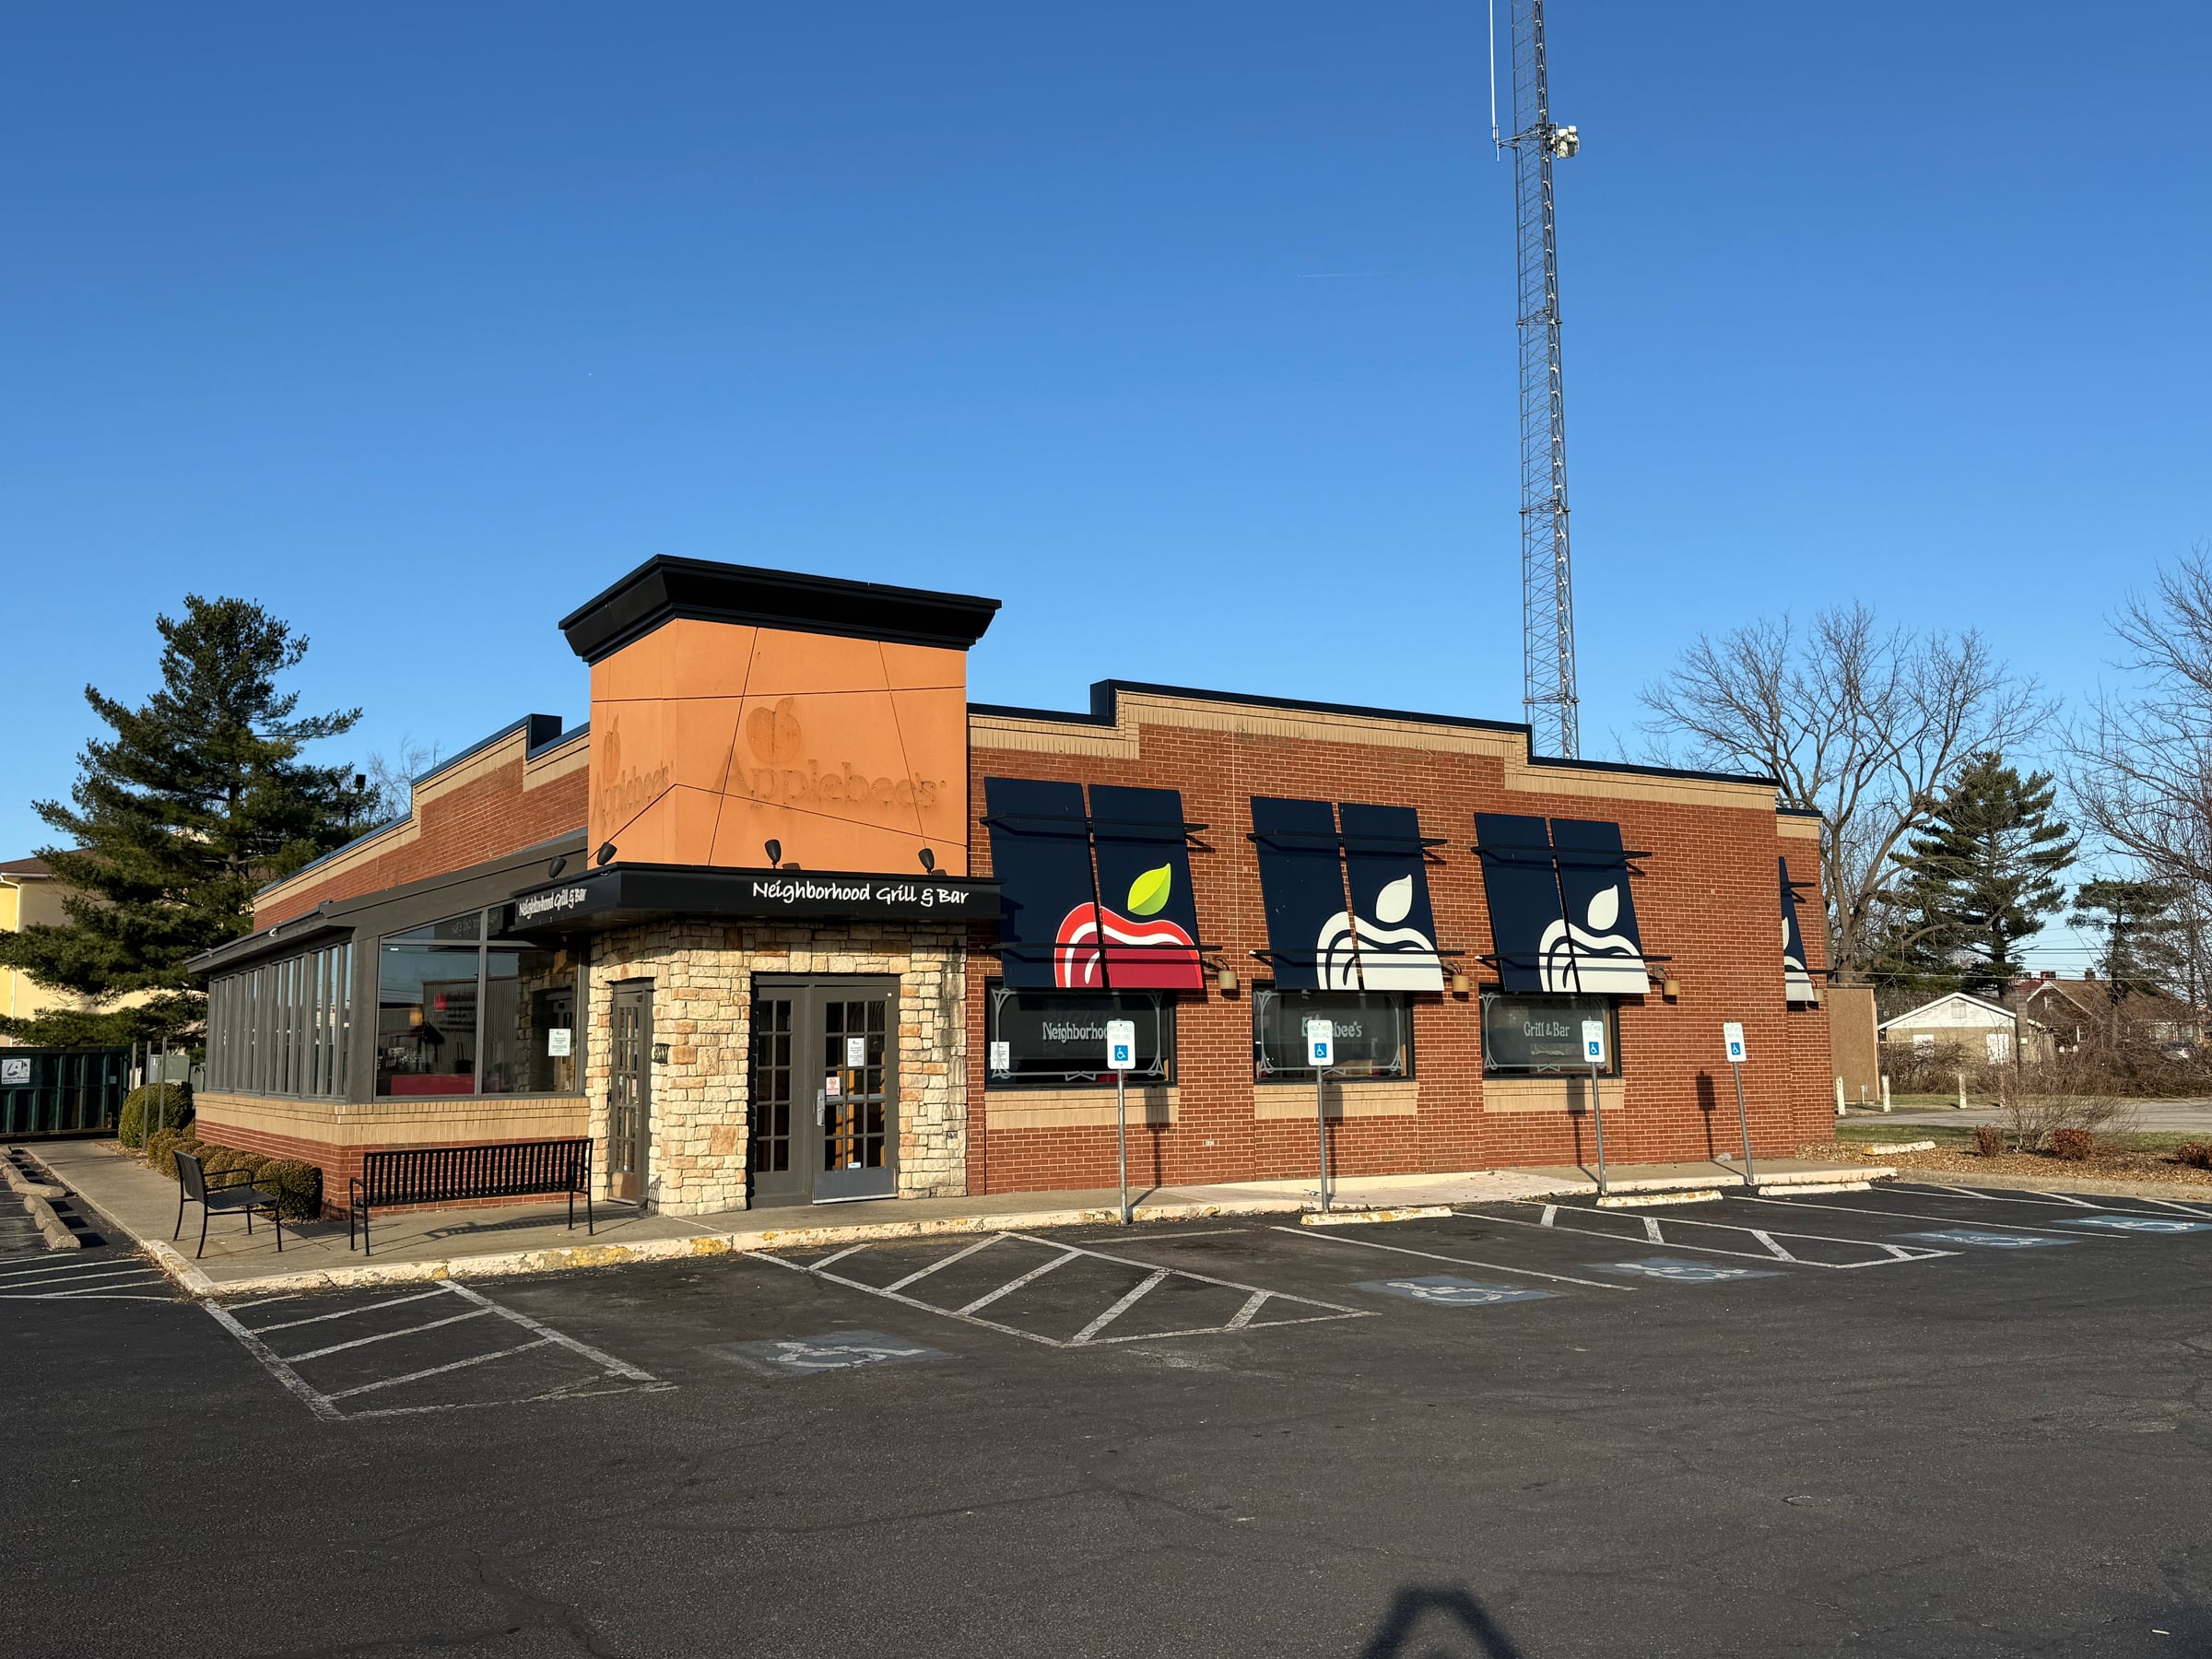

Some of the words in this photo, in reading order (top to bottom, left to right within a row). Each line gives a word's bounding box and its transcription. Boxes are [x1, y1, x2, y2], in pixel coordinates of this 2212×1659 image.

[752, 879, 871, 904] Neighborhood
[876, 885, 917, 905] Grill
[920, 888, 934, 907] &
[936, 888, 970, 905] Bar
[1042, 1021, 1107, 1043] Neighborho
[1524, 1020, 1545, 1037] Grill
[1546, 1023, 1552, 1036] &
[1553, 1021, 1571, 1037] Bar
